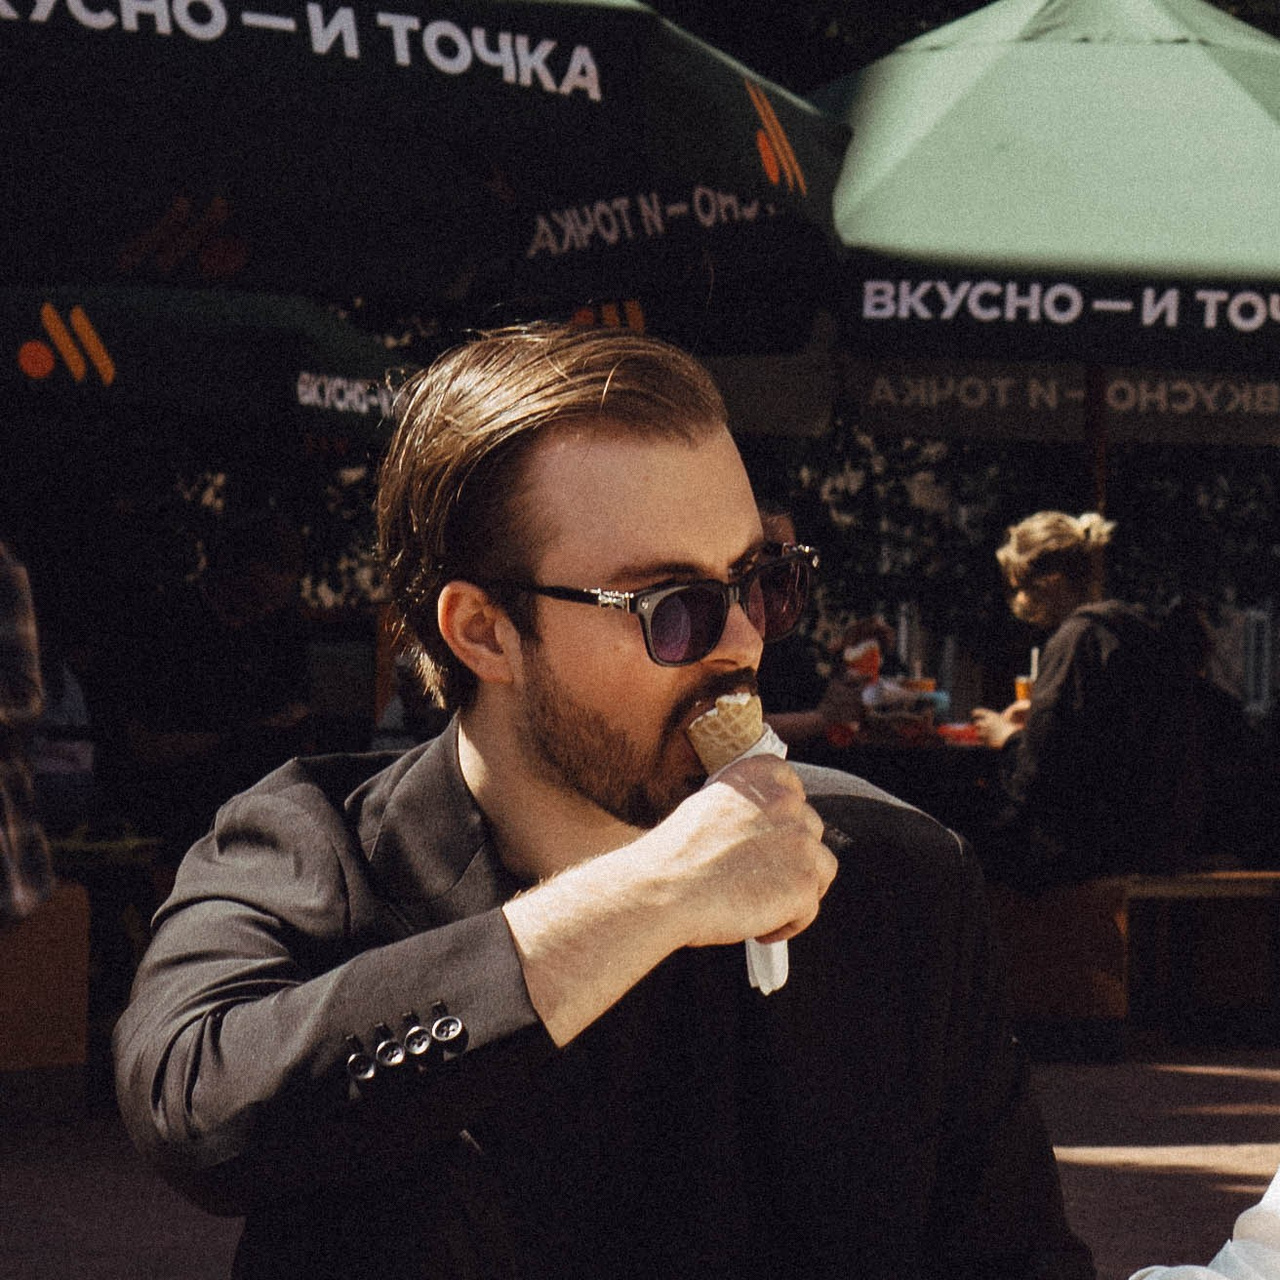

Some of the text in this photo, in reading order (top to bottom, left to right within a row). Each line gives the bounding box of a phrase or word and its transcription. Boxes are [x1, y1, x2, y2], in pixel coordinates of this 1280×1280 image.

[306, 2, 360, 59] И
[376, 13, 601, 100] ТОЧКА
[863, 280, 1083, 324] ВКУСНО
[1142, 287, 1180, 326] И
